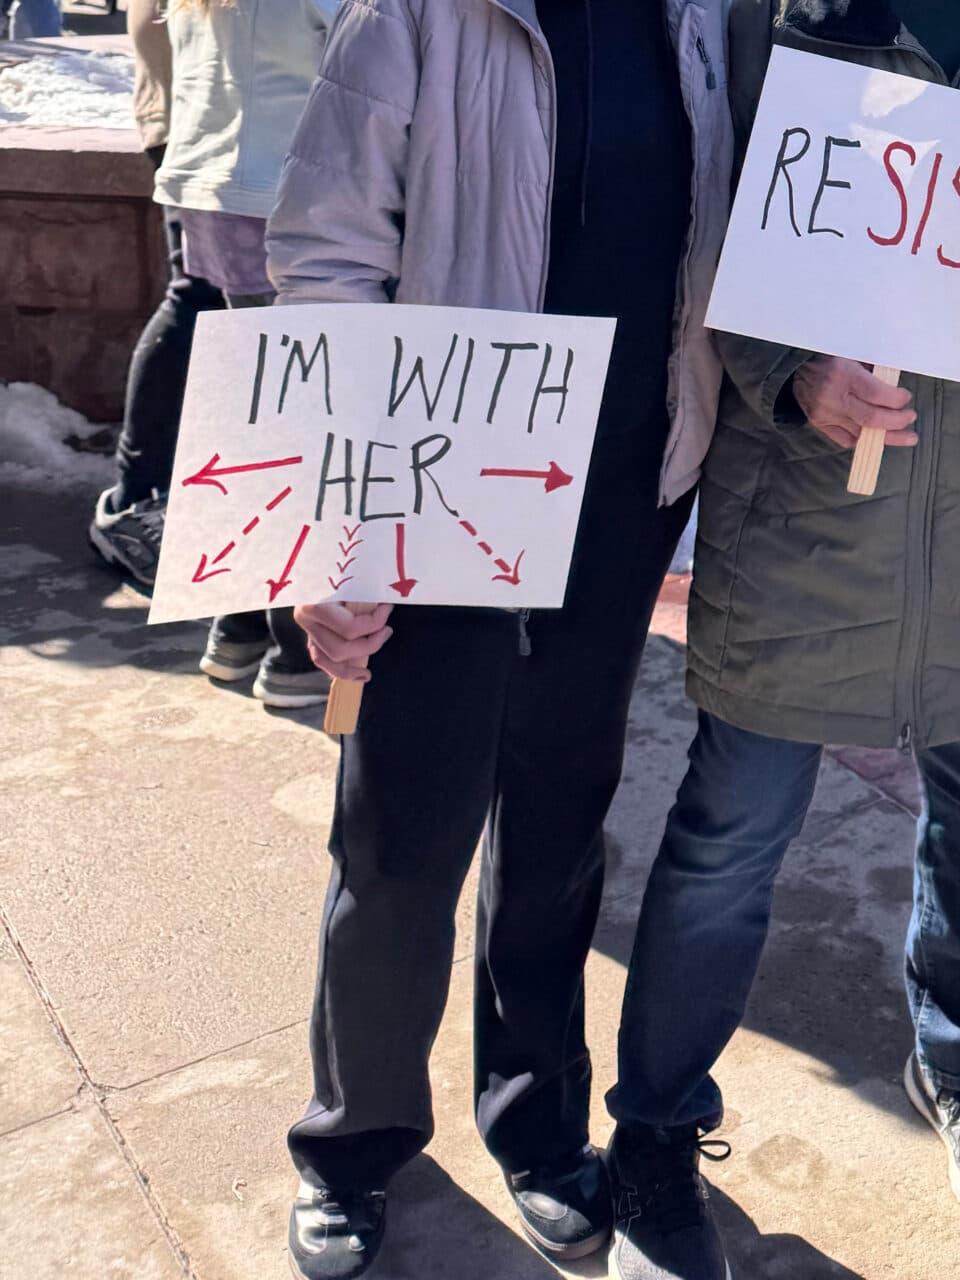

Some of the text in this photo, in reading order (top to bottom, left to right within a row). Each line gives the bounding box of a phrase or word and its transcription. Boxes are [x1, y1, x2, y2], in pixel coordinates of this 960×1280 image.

[248, 332, 575, 433] I'M WITH
[315, 431, 460, 522] HER
